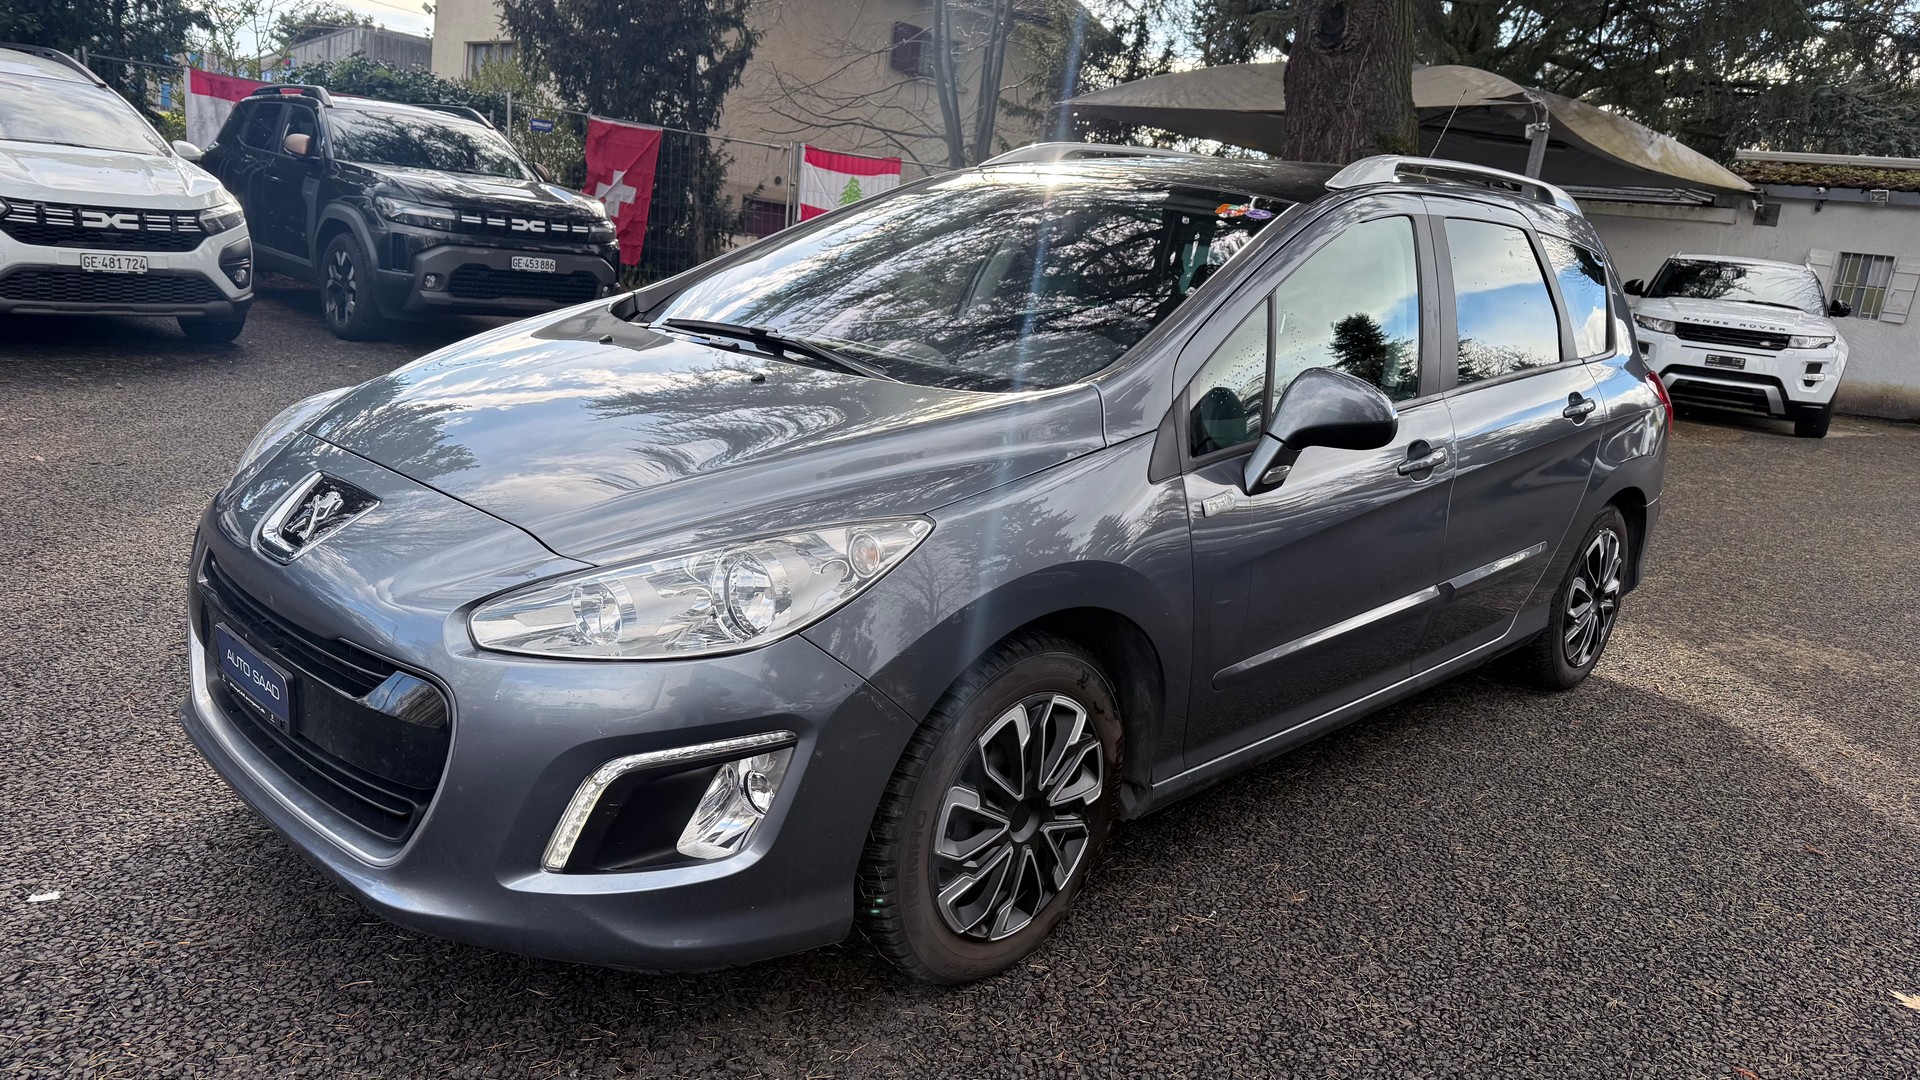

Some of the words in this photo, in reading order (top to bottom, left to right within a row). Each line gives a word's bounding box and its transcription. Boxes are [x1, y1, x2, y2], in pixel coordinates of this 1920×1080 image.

[1683, 316, 1729, 326] RANGE
[1739, 323, 1786, 332] ROVER
[226, 649, 251, 677] AUTO
[252, 669, 280, 701] SAAD
